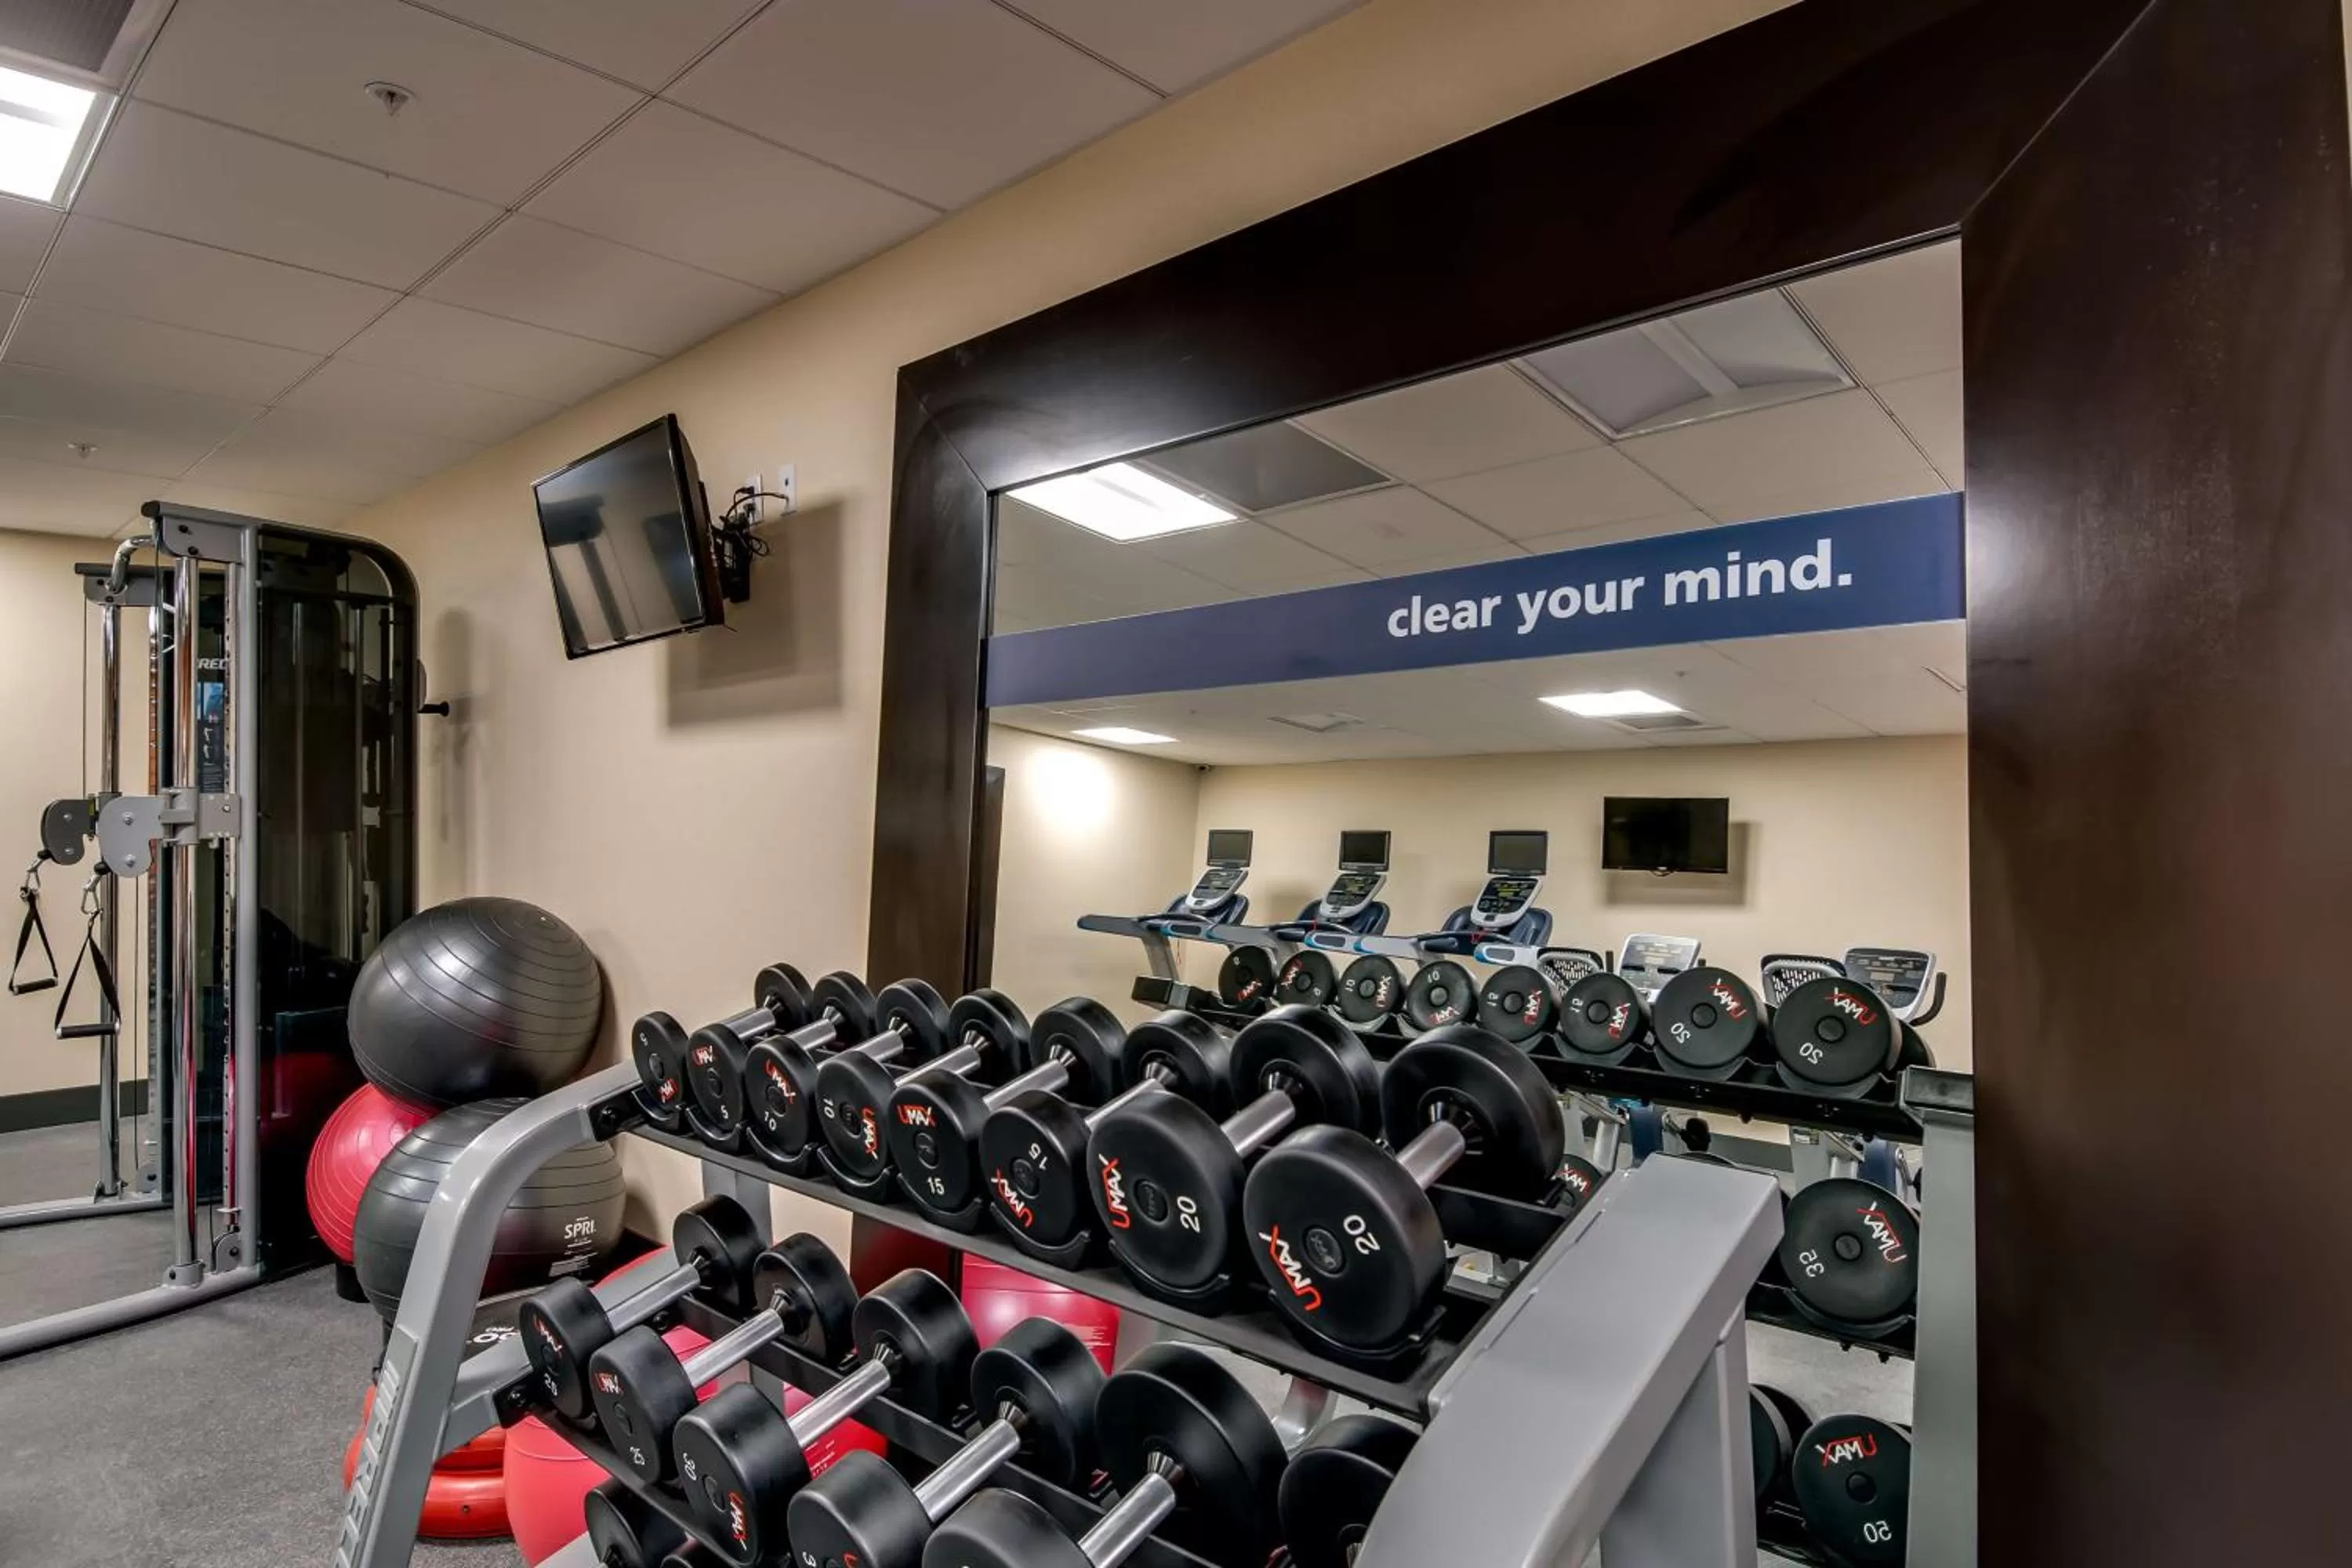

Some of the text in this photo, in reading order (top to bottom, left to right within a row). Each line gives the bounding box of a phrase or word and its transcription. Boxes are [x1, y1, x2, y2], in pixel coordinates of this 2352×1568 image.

[1387, 539, 1853, 637] clear your mind.
[198, 657, 227, 670] REC
[720, 1105, 728, 1119] 5
[764, 1111, 777, 1131] 10
[823, 1098, 835, 1119] 10
[897, 1104, 937, 1127] UMAX
[1028, 1142, 1048, 1171] 15
[927, 1176, 945, 1195] 15
[991, 1167, 1033, 1228] UMAX
[1098, 1153, 1131, 1229] UMAX
[1177, 1196, 1200, 1233] 20
[564, 1219, 595, 1239] SPRI
[1343, 1214, 1380, 1254] 20
[1258, 1224, 1323, 1311] UMAX
[683, 1453, 697, 1481] 30
[802, 1552, 817, 1568] 3
